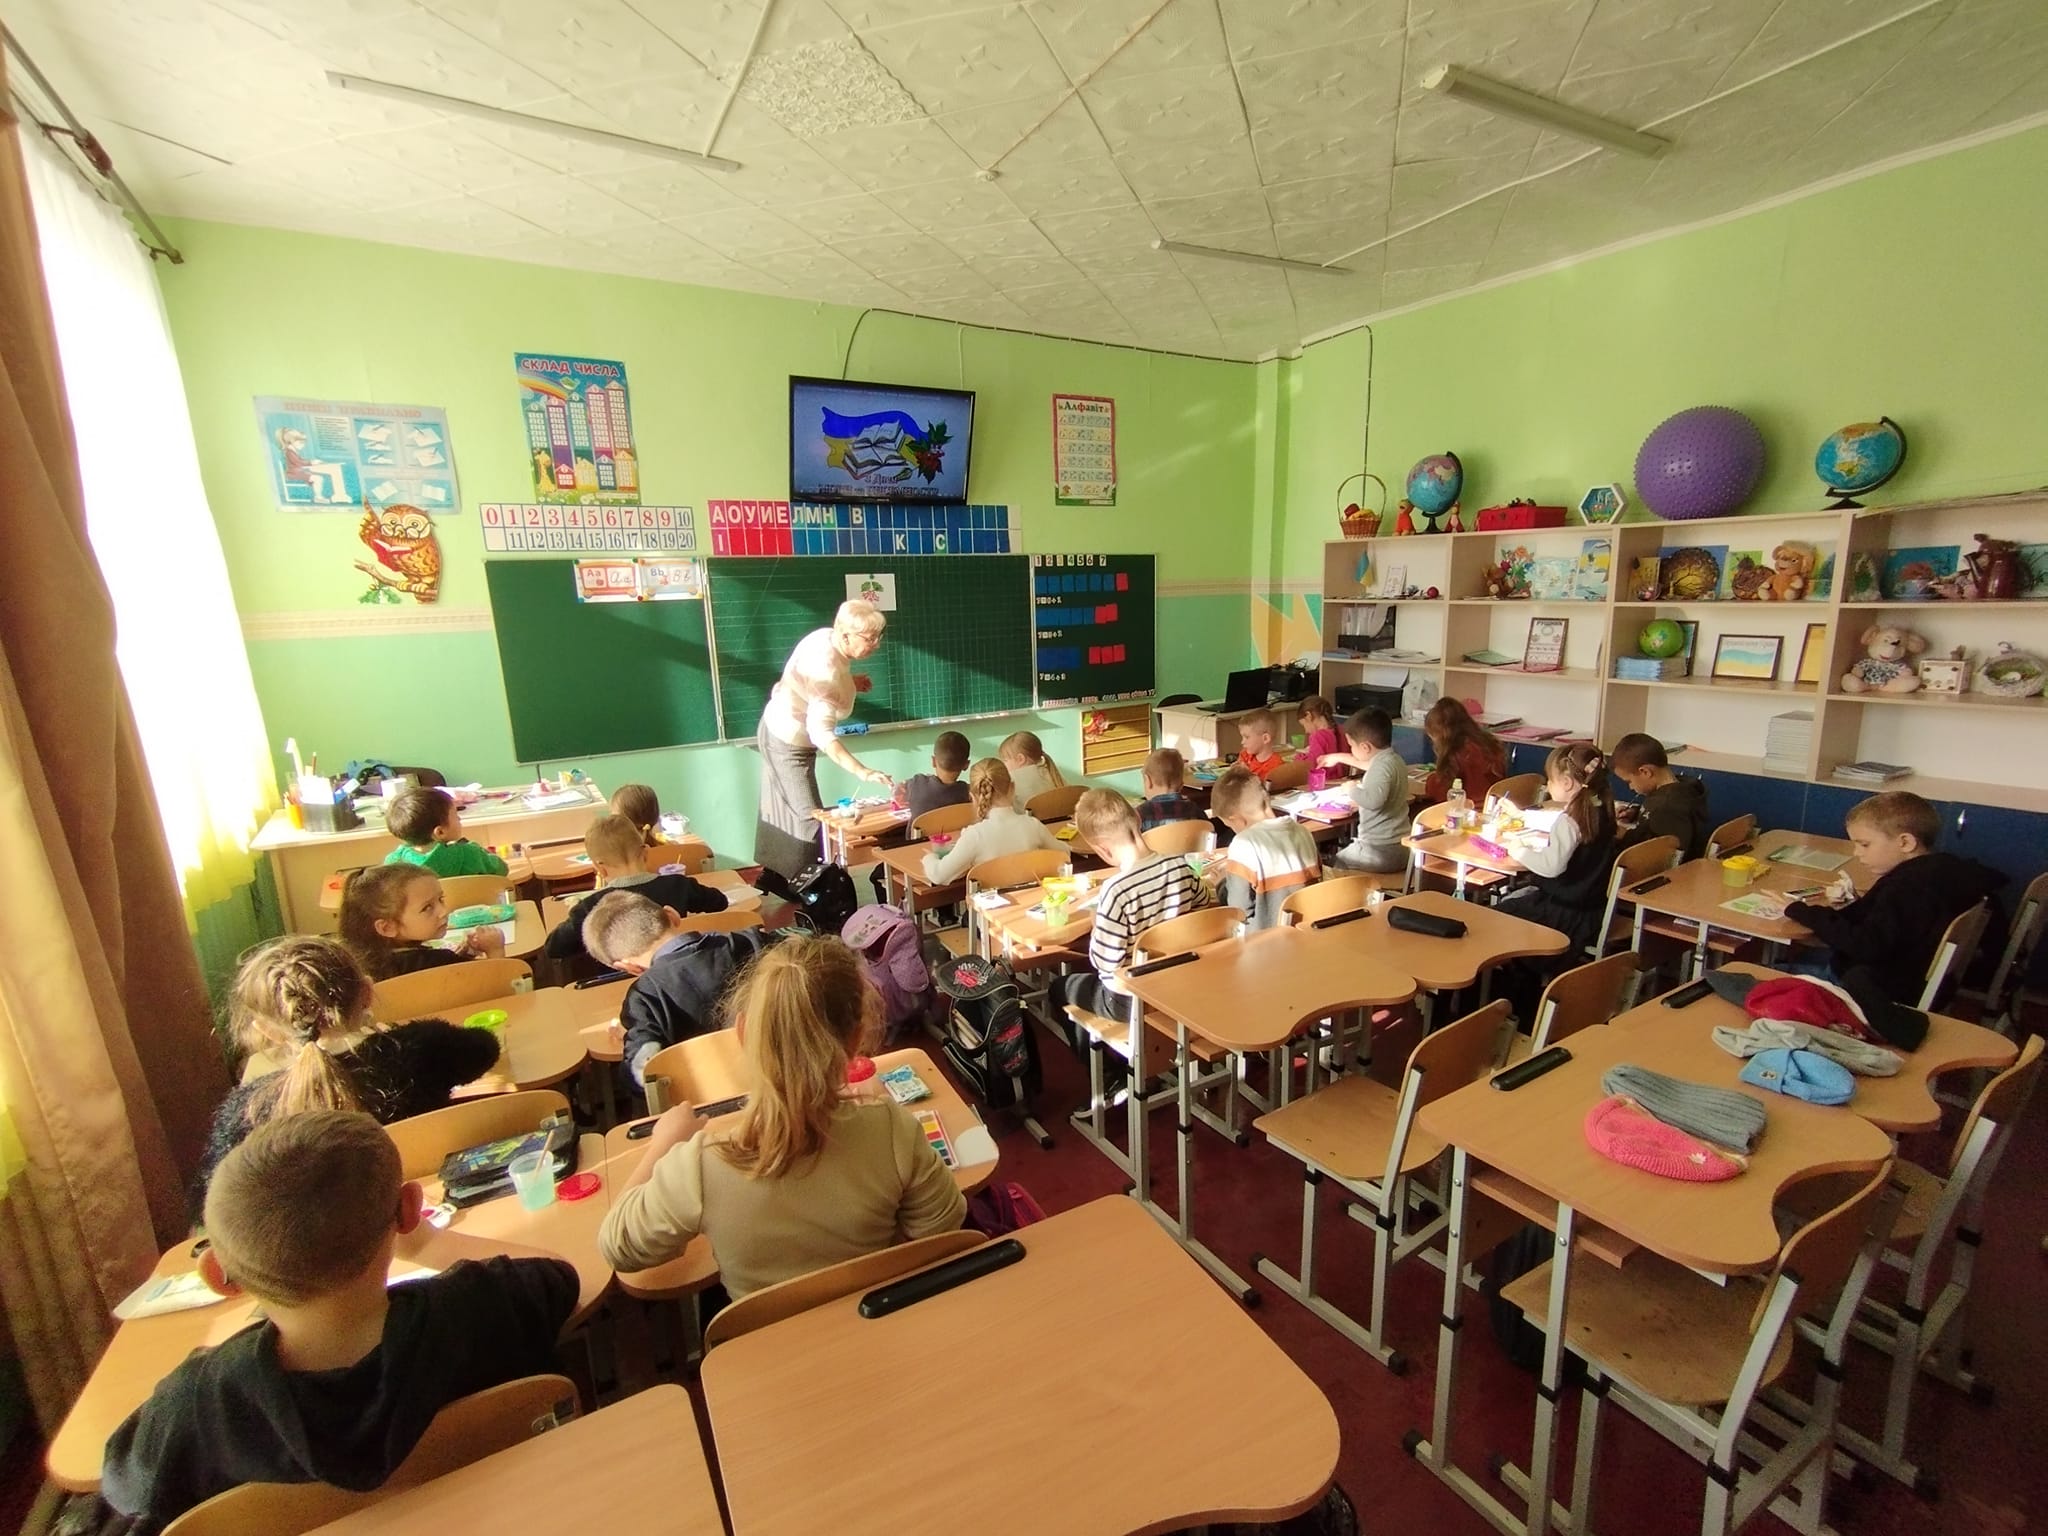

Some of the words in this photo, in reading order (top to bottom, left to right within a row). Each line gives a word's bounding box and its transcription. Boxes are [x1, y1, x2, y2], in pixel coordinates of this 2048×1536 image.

[522, 359, 570, 374] СКЛАД
[575, 363, 620, 376] ЧИСЛА
[1064, 401, 1104, 413] Алфавіт
[486, 507, 499, 525] 0
[508, 508, 519, 525] 1
[527, 508, 540, 525] 2
[548, 508, 560, 525] 3
[567, 509, 580, 526] 4
[587, 509, 598, 526] 5
[606, 509, 617, 526] 6
[624, 510, 634, 526] 7
[643, 510, 654, 527] 8
[660, 510, 671, 527] 9
[678, 511, 690, 527] 10
[852, 507, 863, 524] В
[510, 532, 524, 548] 11
[529, 531, 545, 548] 12
[549, 531, 565, 548] 13
[568, 532, 584, 548] 14
[589, 532, 603, 548] 15
[608, 532, 622, 548] 16
[626, 533, 638, 548] 17
[644, 532, 658, 549] 18
[662, 532, 675, 548] 19
[679, 532, 693, 548] 20
